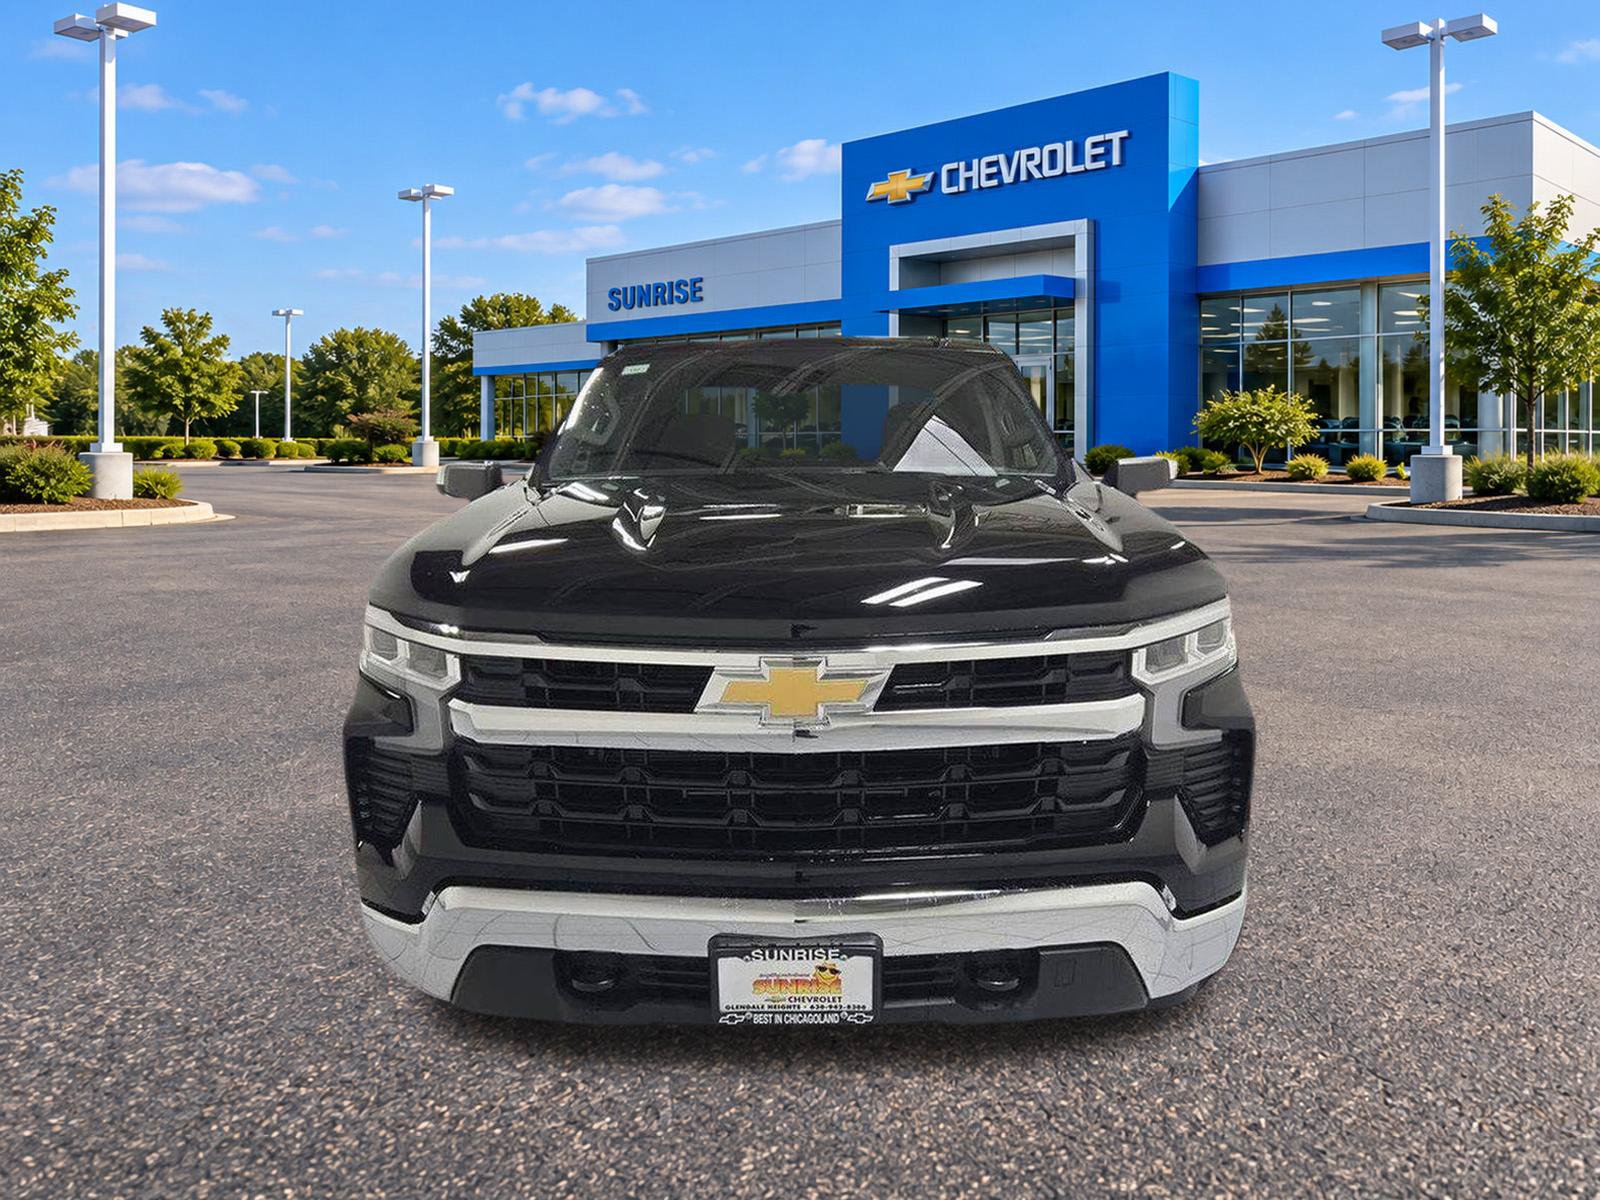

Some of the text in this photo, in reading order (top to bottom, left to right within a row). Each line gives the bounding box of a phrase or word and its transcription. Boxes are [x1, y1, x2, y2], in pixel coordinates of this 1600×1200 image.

[941, 130, 1129, 195] CHEVROLET
[608, 277, 704, 312] SUNRISE
[751, 949, 839, 961] SUNRISE
[787, 995, 842, 1003] CHEVROLET
[753, 1013, 840, 1024] BEST IN CHICAGOLAND
